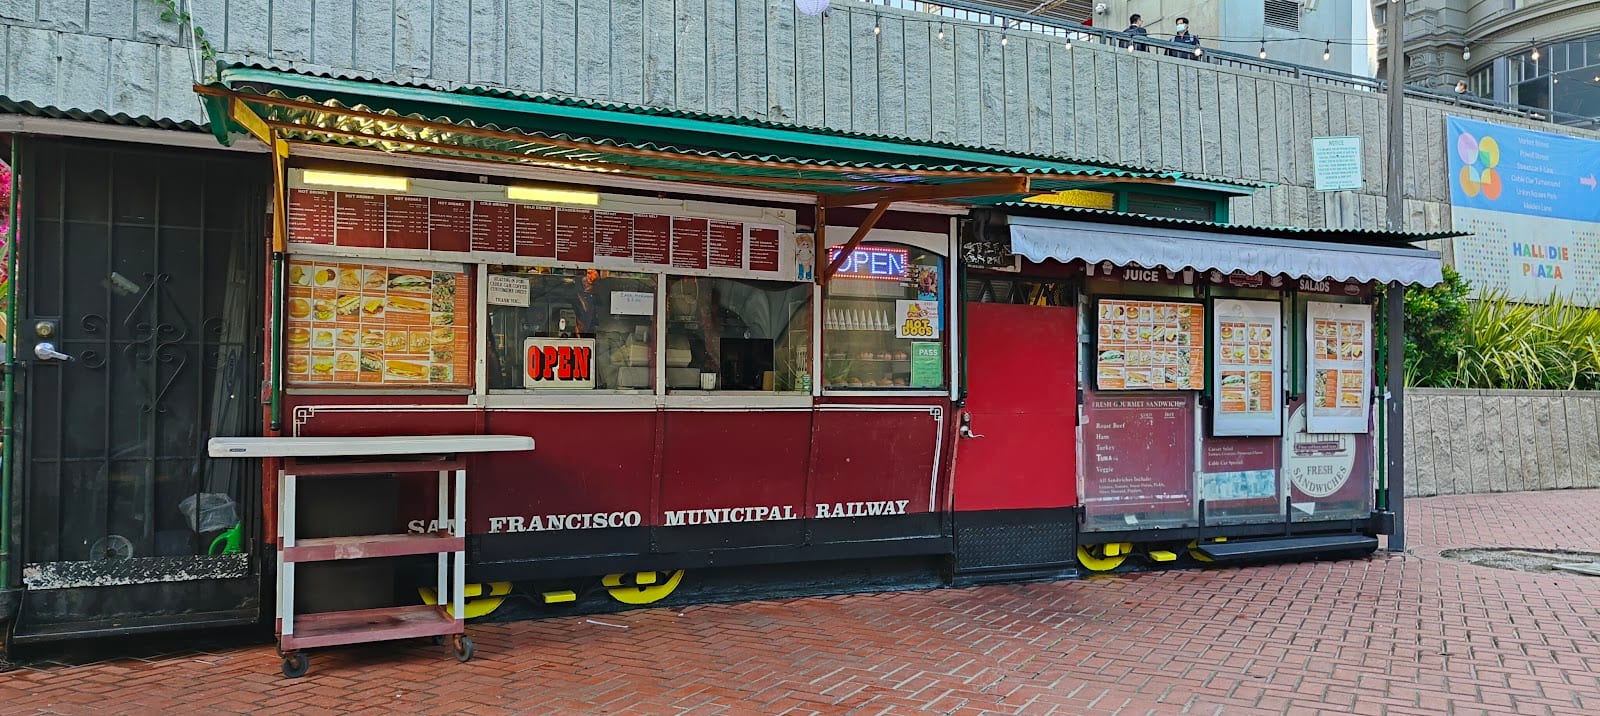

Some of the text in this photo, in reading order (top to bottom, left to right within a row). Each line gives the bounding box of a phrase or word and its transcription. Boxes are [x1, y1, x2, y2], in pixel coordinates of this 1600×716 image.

[1511, 174, 1524, 182] Cable
[1513, 242, 1568, 260] HALLIDIE
[832, 250, 904, 275] OPEN
[1124, 269, 1159, 282] JUICE
[1522, 263, 1562, 279] PLAZA
[1300, 279, 1330, 292] SALADS
[905, 319, 930, 328] HOT
[902, 326, 933, 336] DOGS
[528, 346, 592, 382] OPEN
[1307, 465, 1333, 475] FRESH
[1293, 465, 1347, 493] SANDWICHES
[488, 511, 642, 534] FRANCISCO
[663, 506, 796, 526] MUNICIPAL
[815, 500, 909, 519] RAILWAY
